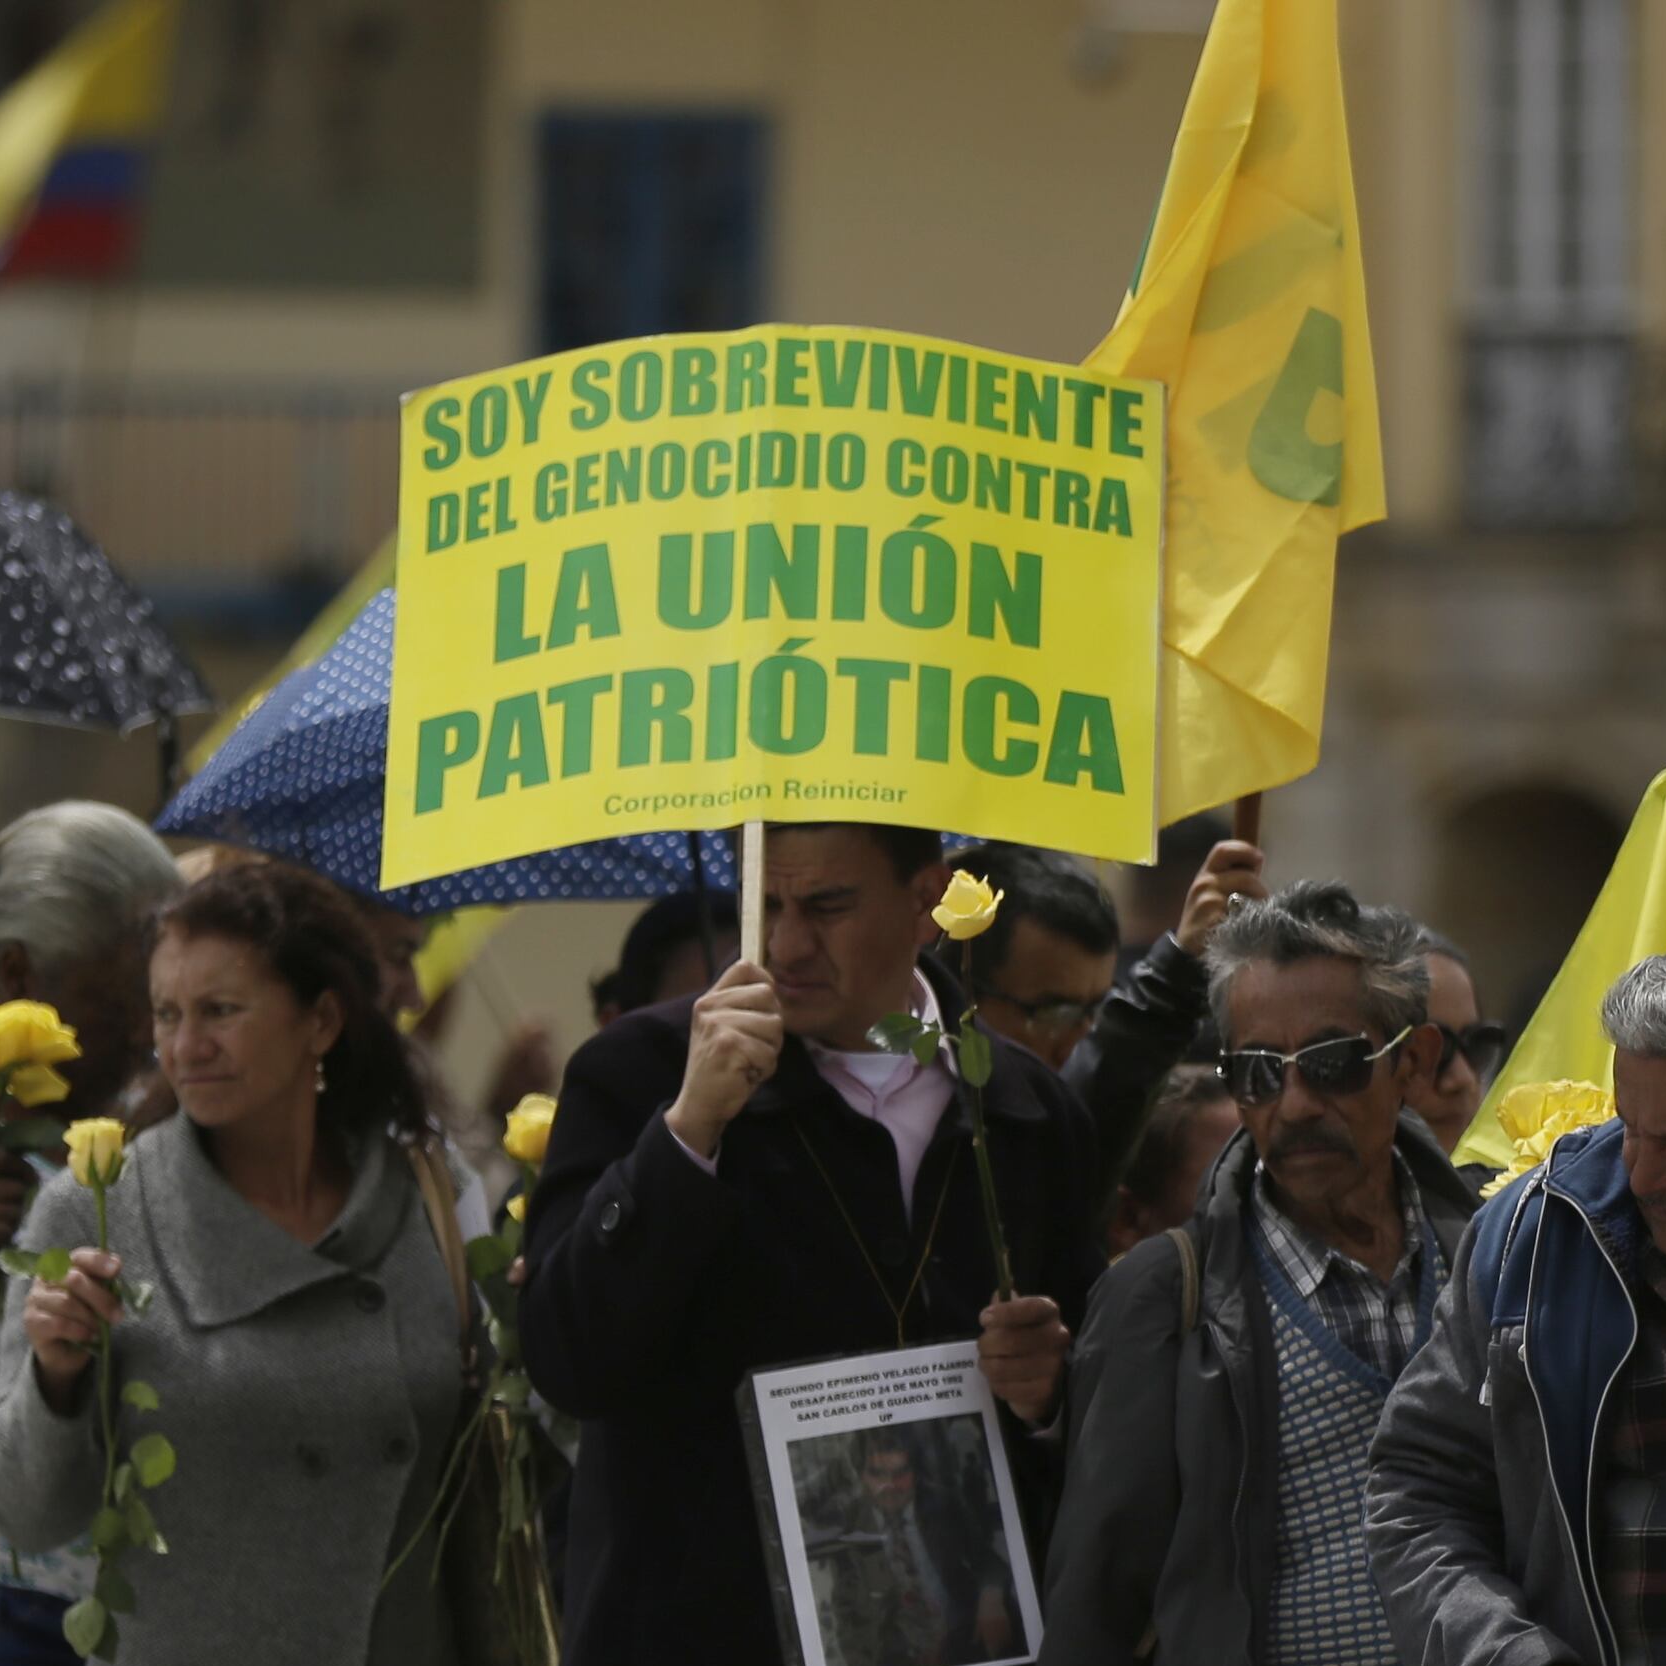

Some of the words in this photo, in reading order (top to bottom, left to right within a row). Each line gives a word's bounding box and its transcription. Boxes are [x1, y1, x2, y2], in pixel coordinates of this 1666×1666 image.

[423, 370, 552, 471] SOY
[569, 337, 1145, 459] SOBREVIVIENTE
[427, 484, 517, 555] DEL
[535, 430, 867, 524] GENOCIDIO
[886, 437, 1134, 538] CONTRA
[493, 542, 622, 664] LA
[656, 514, 1044, 650] UNIÓN
[414, 636, 1127, 816] PATRIÓTICA
[603, 784, 773, 818] Corporacion
[782, 777, 909, 806] Reiniciar
[769, 1382, 824, 1399] SEGUNDO
[882, 1364, 930, 1381] VELASCO
[790, 1388, 876, 1410] DESAPARECIDO
[893, 1382, 907, 1394] DE
[909, 1377, 939, 1391] MAYO
[796, 1412, 821, 1423] SAN
[822, 1402, 868, 1419] CARLOS
[870, 1400, 885, 1411] DE
[935, 1388, 963, 1401] META
[878, 1411, 894, 1424] UP
